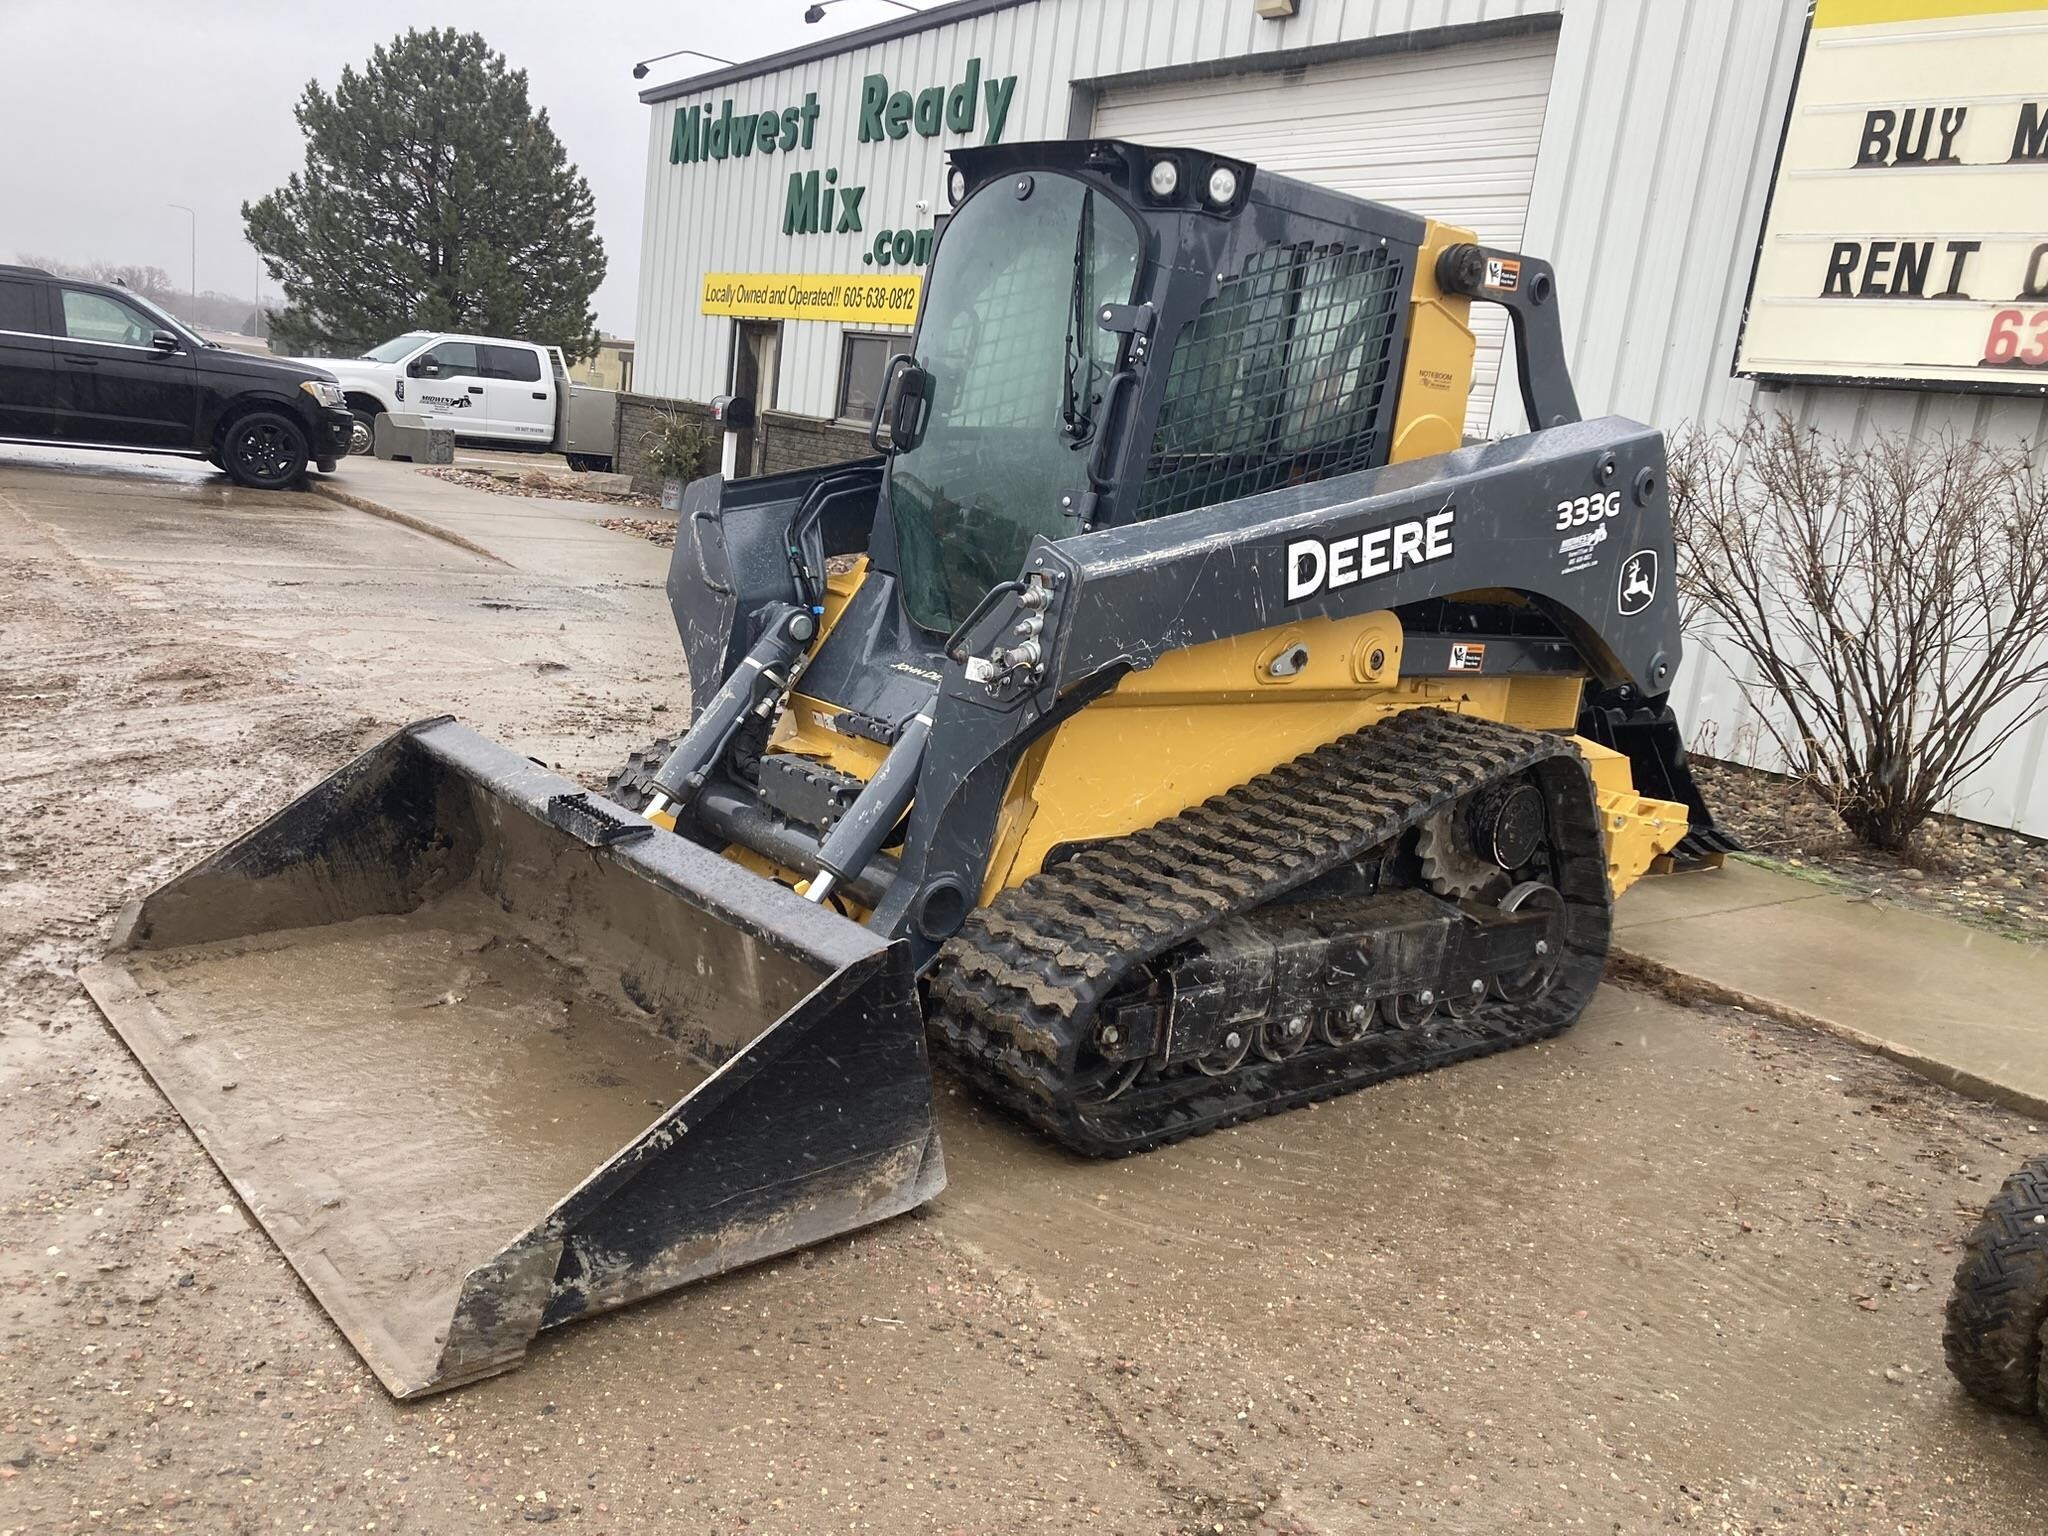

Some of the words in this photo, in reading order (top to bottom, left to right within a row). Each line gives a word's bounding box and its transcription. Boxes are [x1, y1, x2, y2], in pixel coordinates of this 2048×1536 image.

[669, 92, 820, 164] Midwest
[857, 57, 1018, 144] Ready
[1857, 106, 1968, 162] BUY
[782, 168, 866, 235] Mix
[863, 228, 935, 266] .com
[1823, 241, 1983, 296] RENT
[705, 283, 736, 307] Locally
[736, 284, 767, 304] Owned
[769, 285, 788, 304] and
[788, 286, 841, 310] Operated!!
[843, 287, 915, 310] 605-638-0812
[1556, 491, 1620, 530] 333G
[1287, 511, 1455, 602] DEERE
